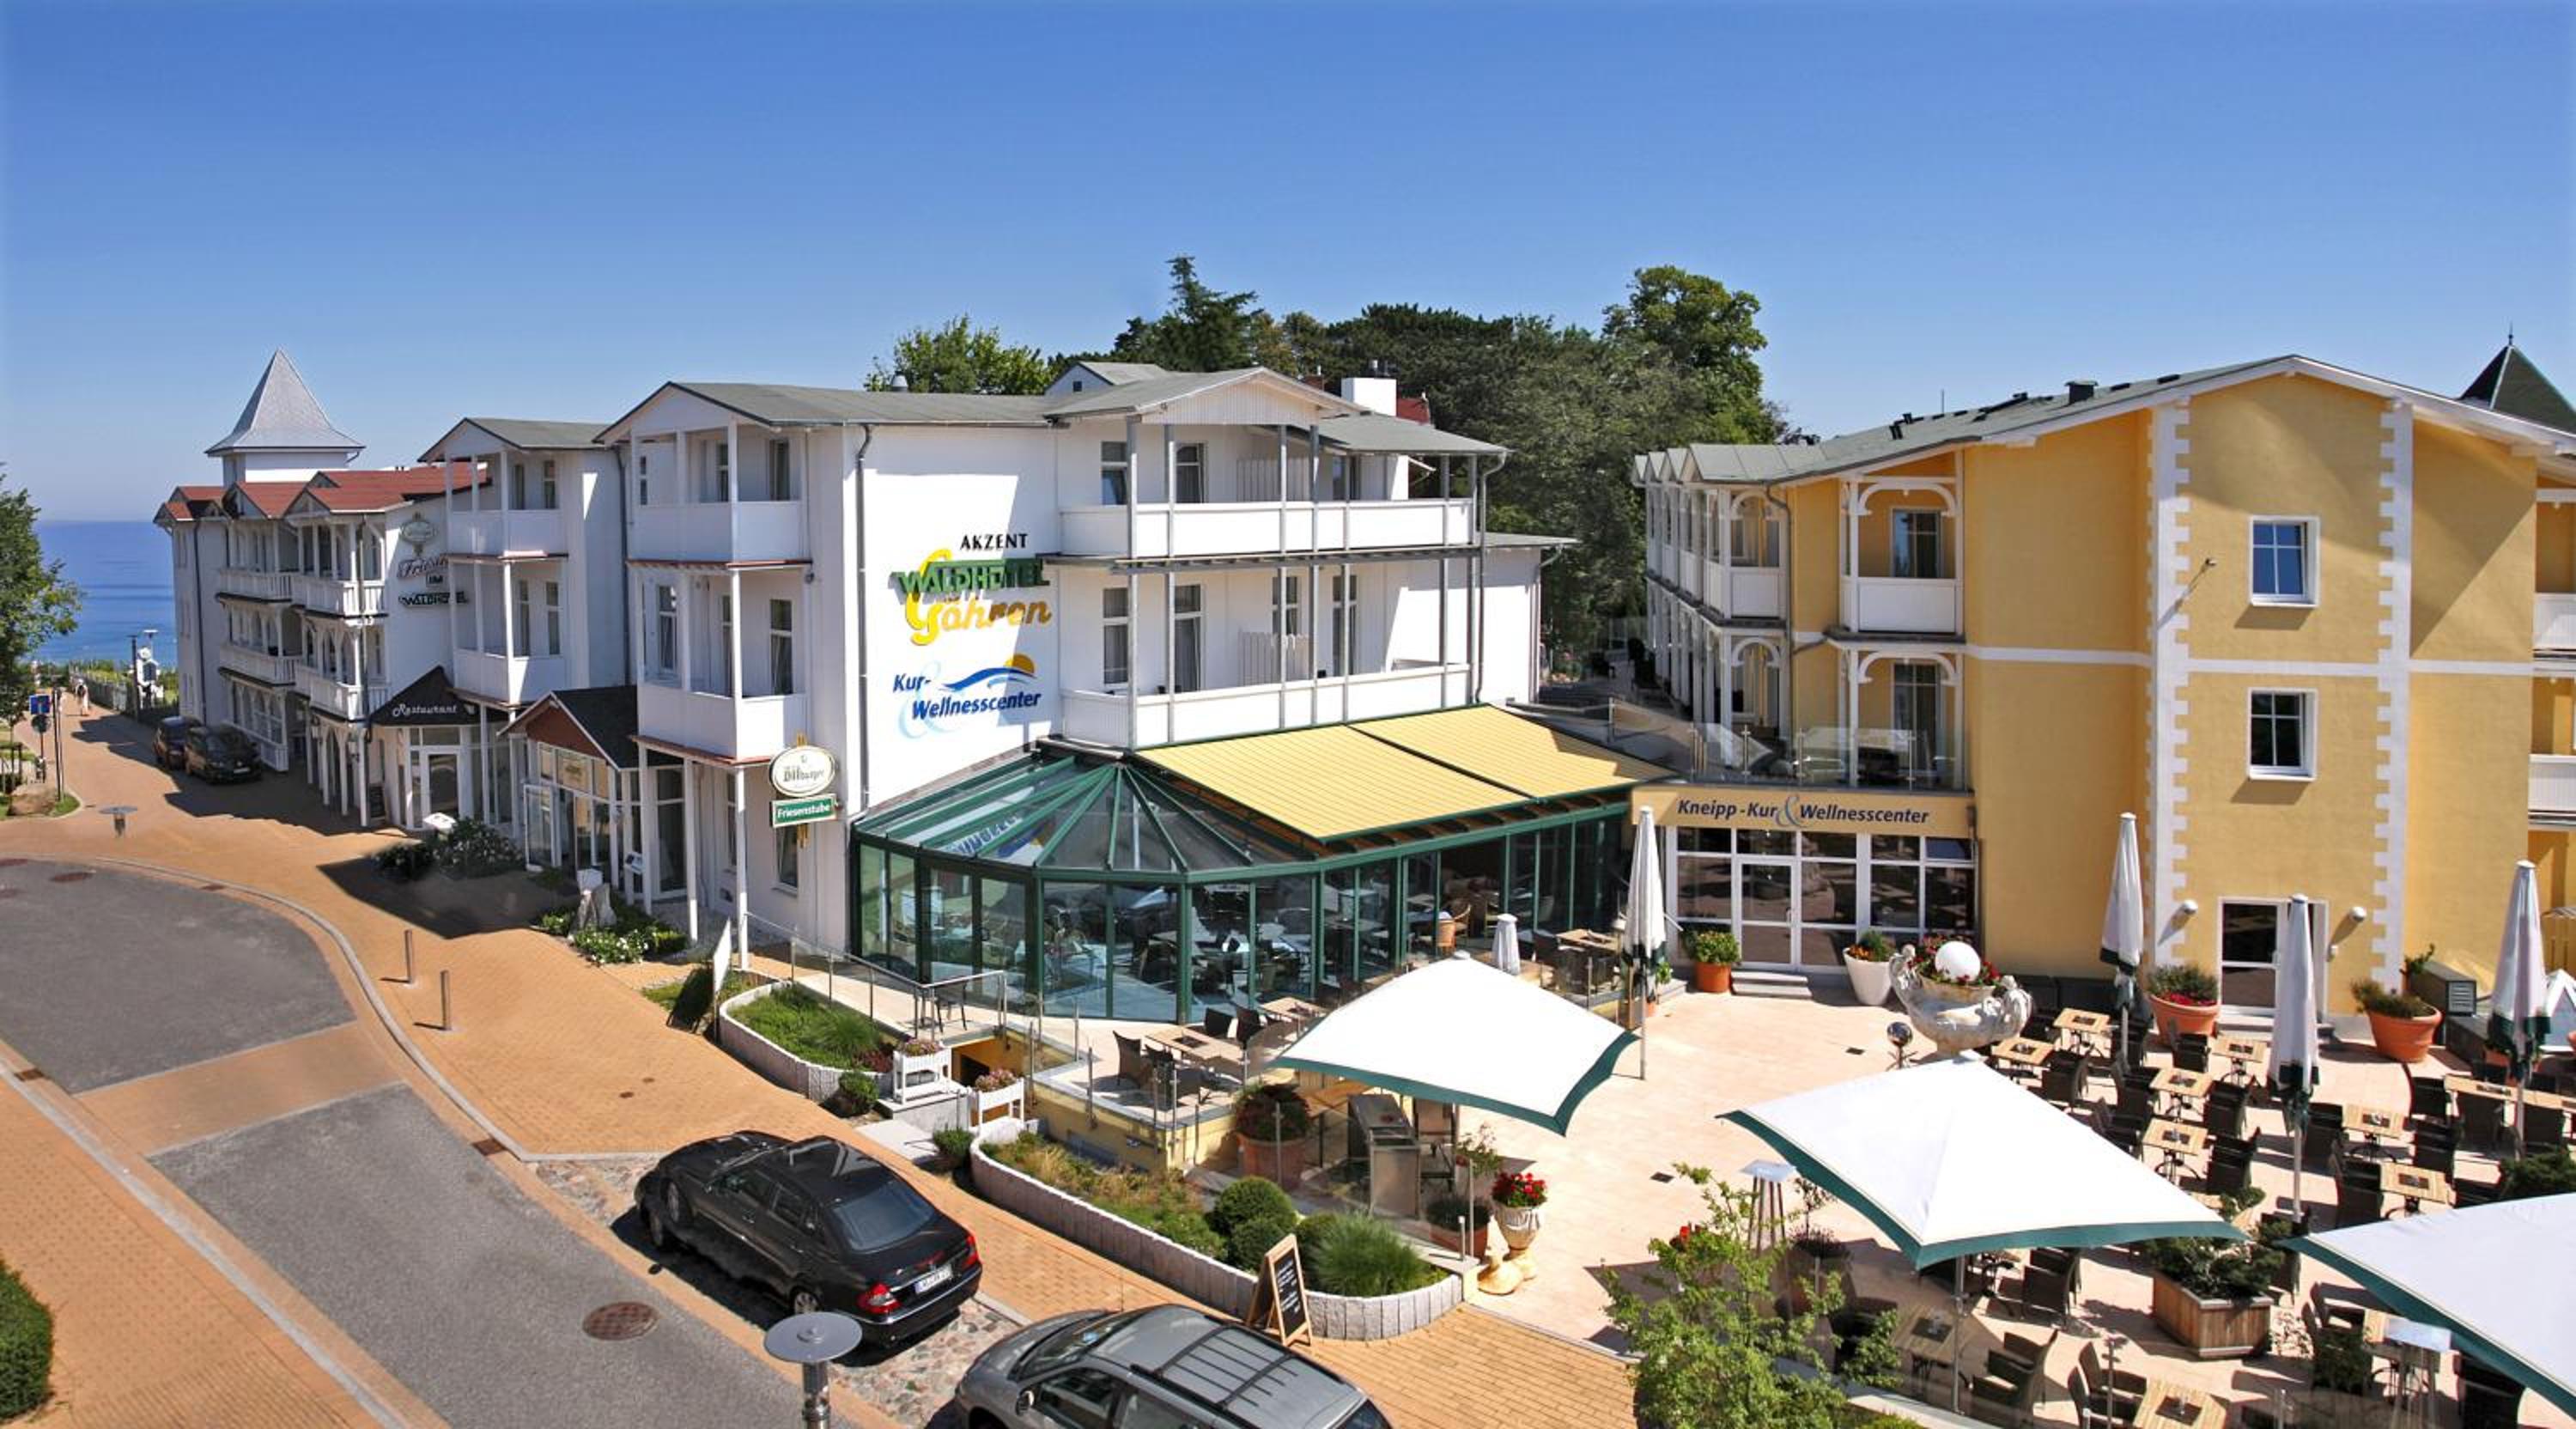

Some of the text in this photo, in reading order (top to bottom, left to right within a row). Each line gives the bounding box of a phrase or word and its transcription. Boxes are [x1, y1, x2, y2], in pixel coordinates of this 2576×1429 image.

[960, 533, 1028, 550] AKZENT
[895, 559, 1050, 597] WALDHOTEL
[398, 593, 469, 605] WALDHOEL
[893, 673, 931, 692] Kur-
[392, 703, 457, 716] Restaurant
[912, 691, 1041, 720] Wellnesscenter
[777, 802, 830, 818] Friesenstube
[1800, 805, 1929, 824] Wellnesscenter
